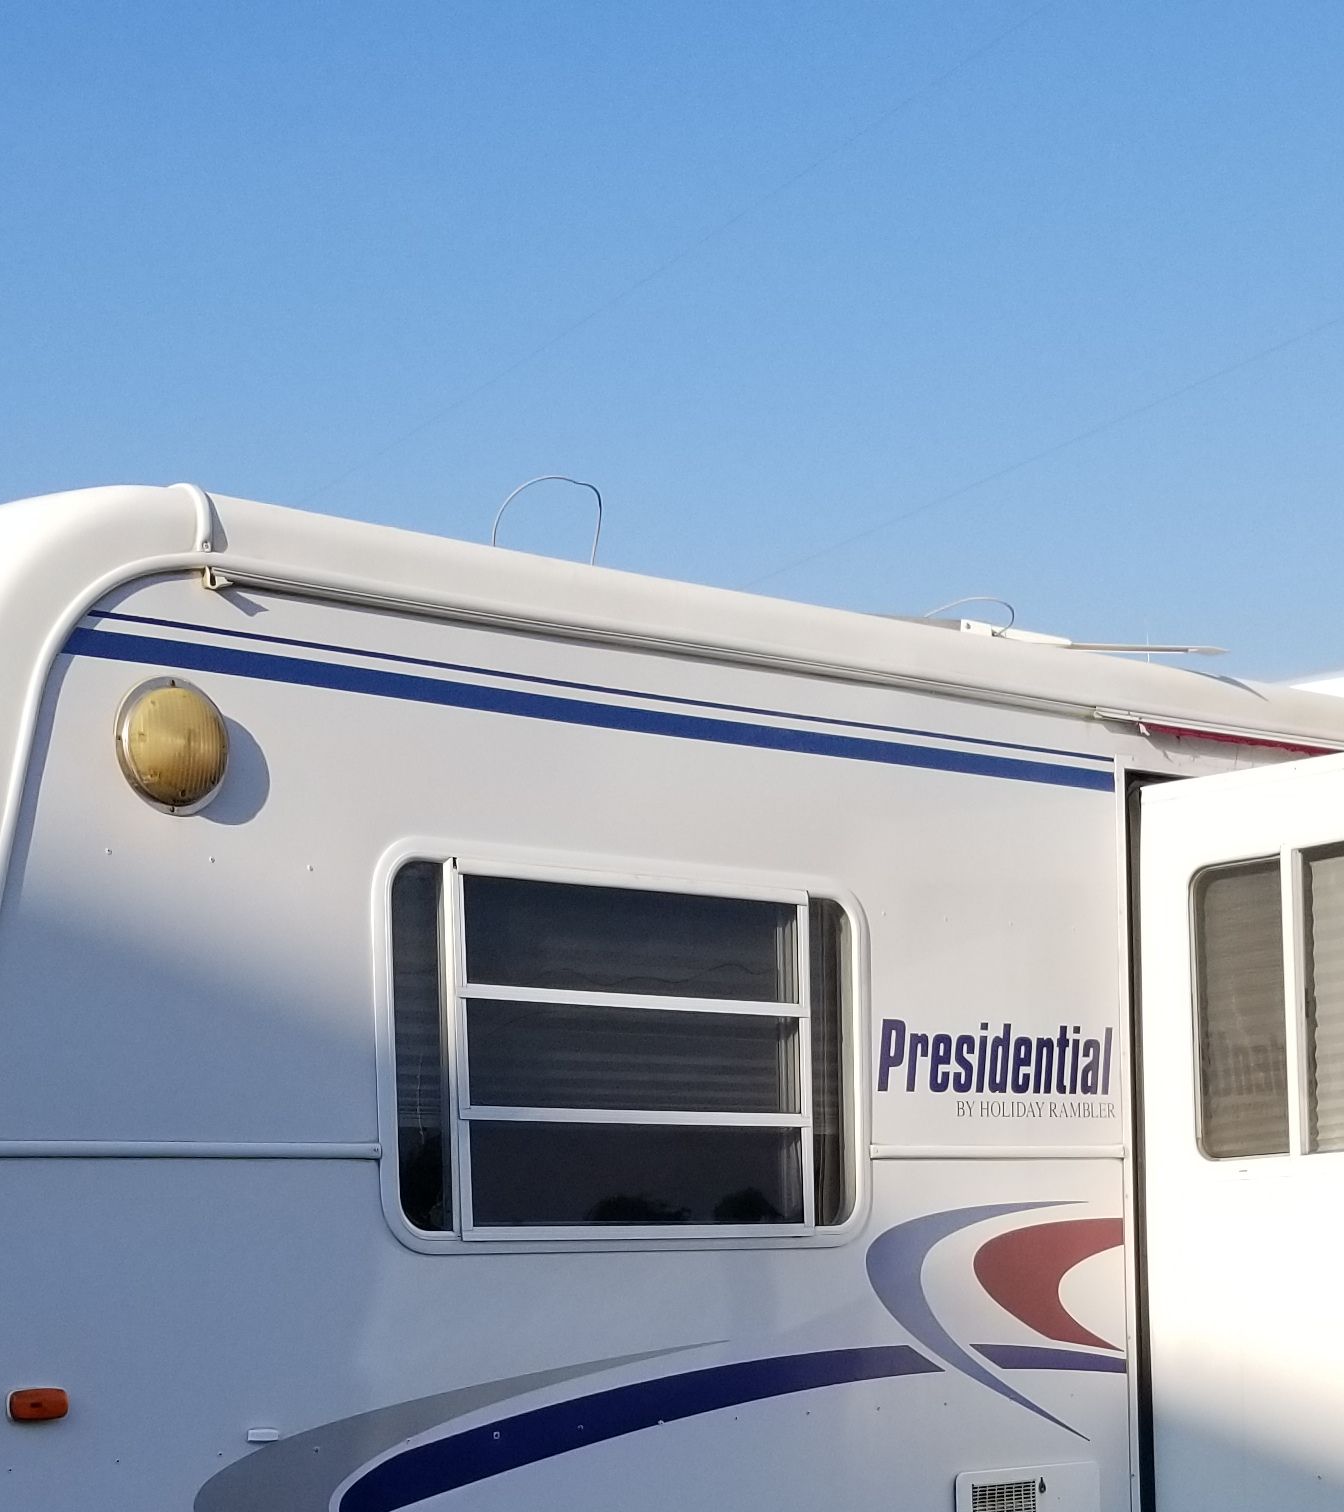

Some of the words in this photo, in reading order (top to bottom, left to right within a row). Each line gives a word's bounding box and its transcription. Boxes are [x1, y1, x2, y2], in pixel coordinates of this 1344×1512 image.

[877, 1018, 1114, 1096] Presidential
[956, 1100, 975, 1118] BY
[979, 1101, 1046, 1119] HOLIDAY
[1049, 1102, 1116, 1119] RAMBLER
